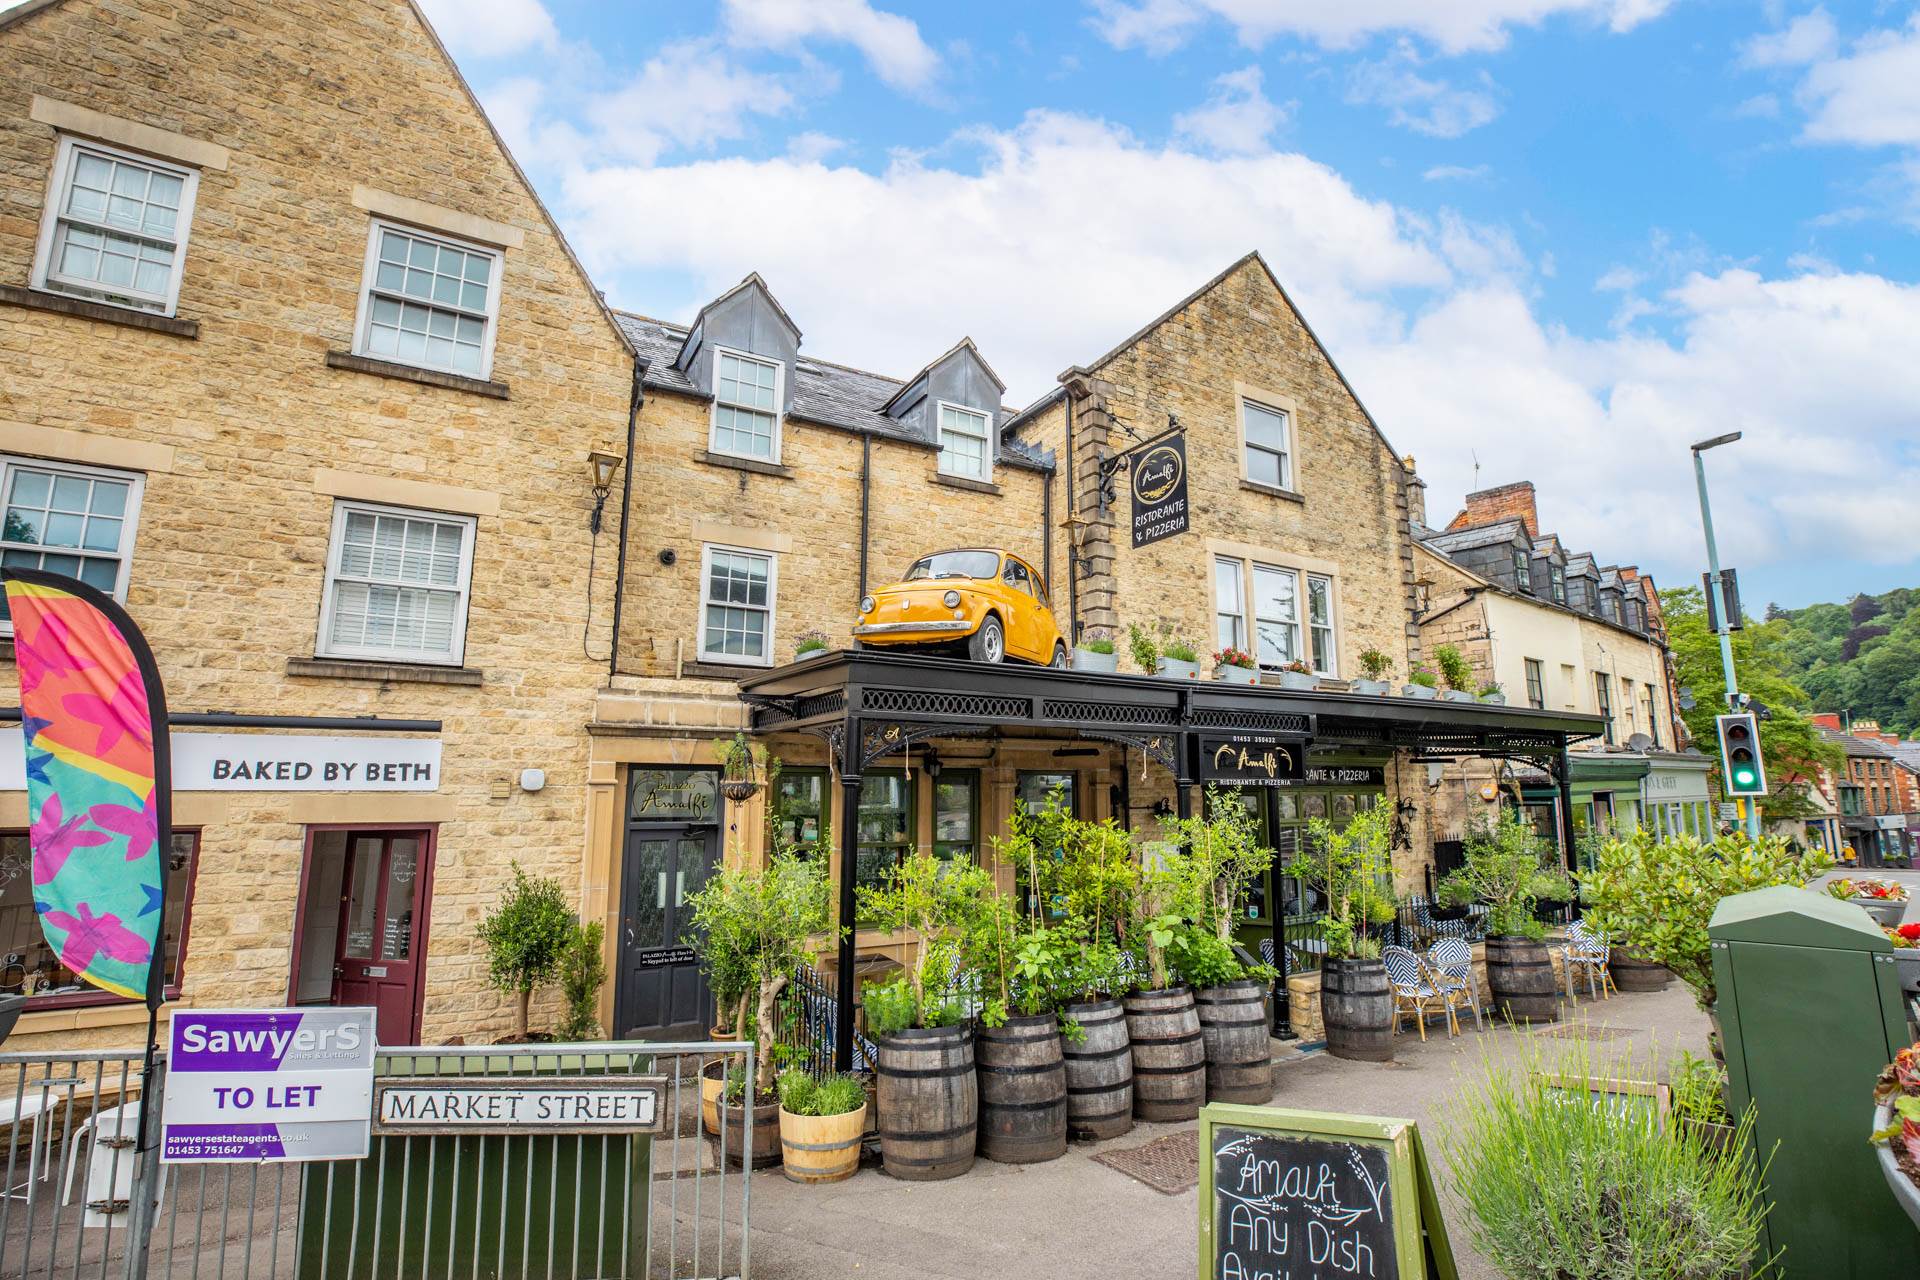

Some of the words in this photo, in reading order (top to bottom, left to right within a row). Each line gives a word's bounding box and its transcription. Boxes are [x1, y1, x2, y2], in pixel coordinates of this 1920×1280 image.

[1142, 463, 1174, 486] Amalfi
[1135, 499, 1184, 528] RISTORANTE
[1136, 531, 1143, 542] &
[1145, 516, 1185, 540] PIZZERIA
[212, 759, 313, 780] BAKED
[323, 762, 358, 781] BY
[366, 763, 431, 782] BETH
[1237, 747, 1277, 778] Amalfi
[657, 783, 695, 791] PALAZZO
[1329, 770, 1336, 781] &
[1338, 769, 1370, 782] PIZZERIA
[640, 788, 708, 821] Amalfi
[289, 1052, 313, 1060] Sales
[324, 1051, 361, 1060] Lettings
[213, 1087, 254, 1109] TO
[266, 1085, 322, 1108] LET
[389, 1095, 524, 1119] MARKET
[537, 1095, 648, 1119] STREET
[167, 1146, 201, 1155] 01453
[204, 1145, 244, 1154] 751647
[168, 1133, 310, 1144] sawyersestateagents.co.uk
[1231, 1204, 1288, 1254] Any
[1308, 1221, 1375, 1277] Dish
